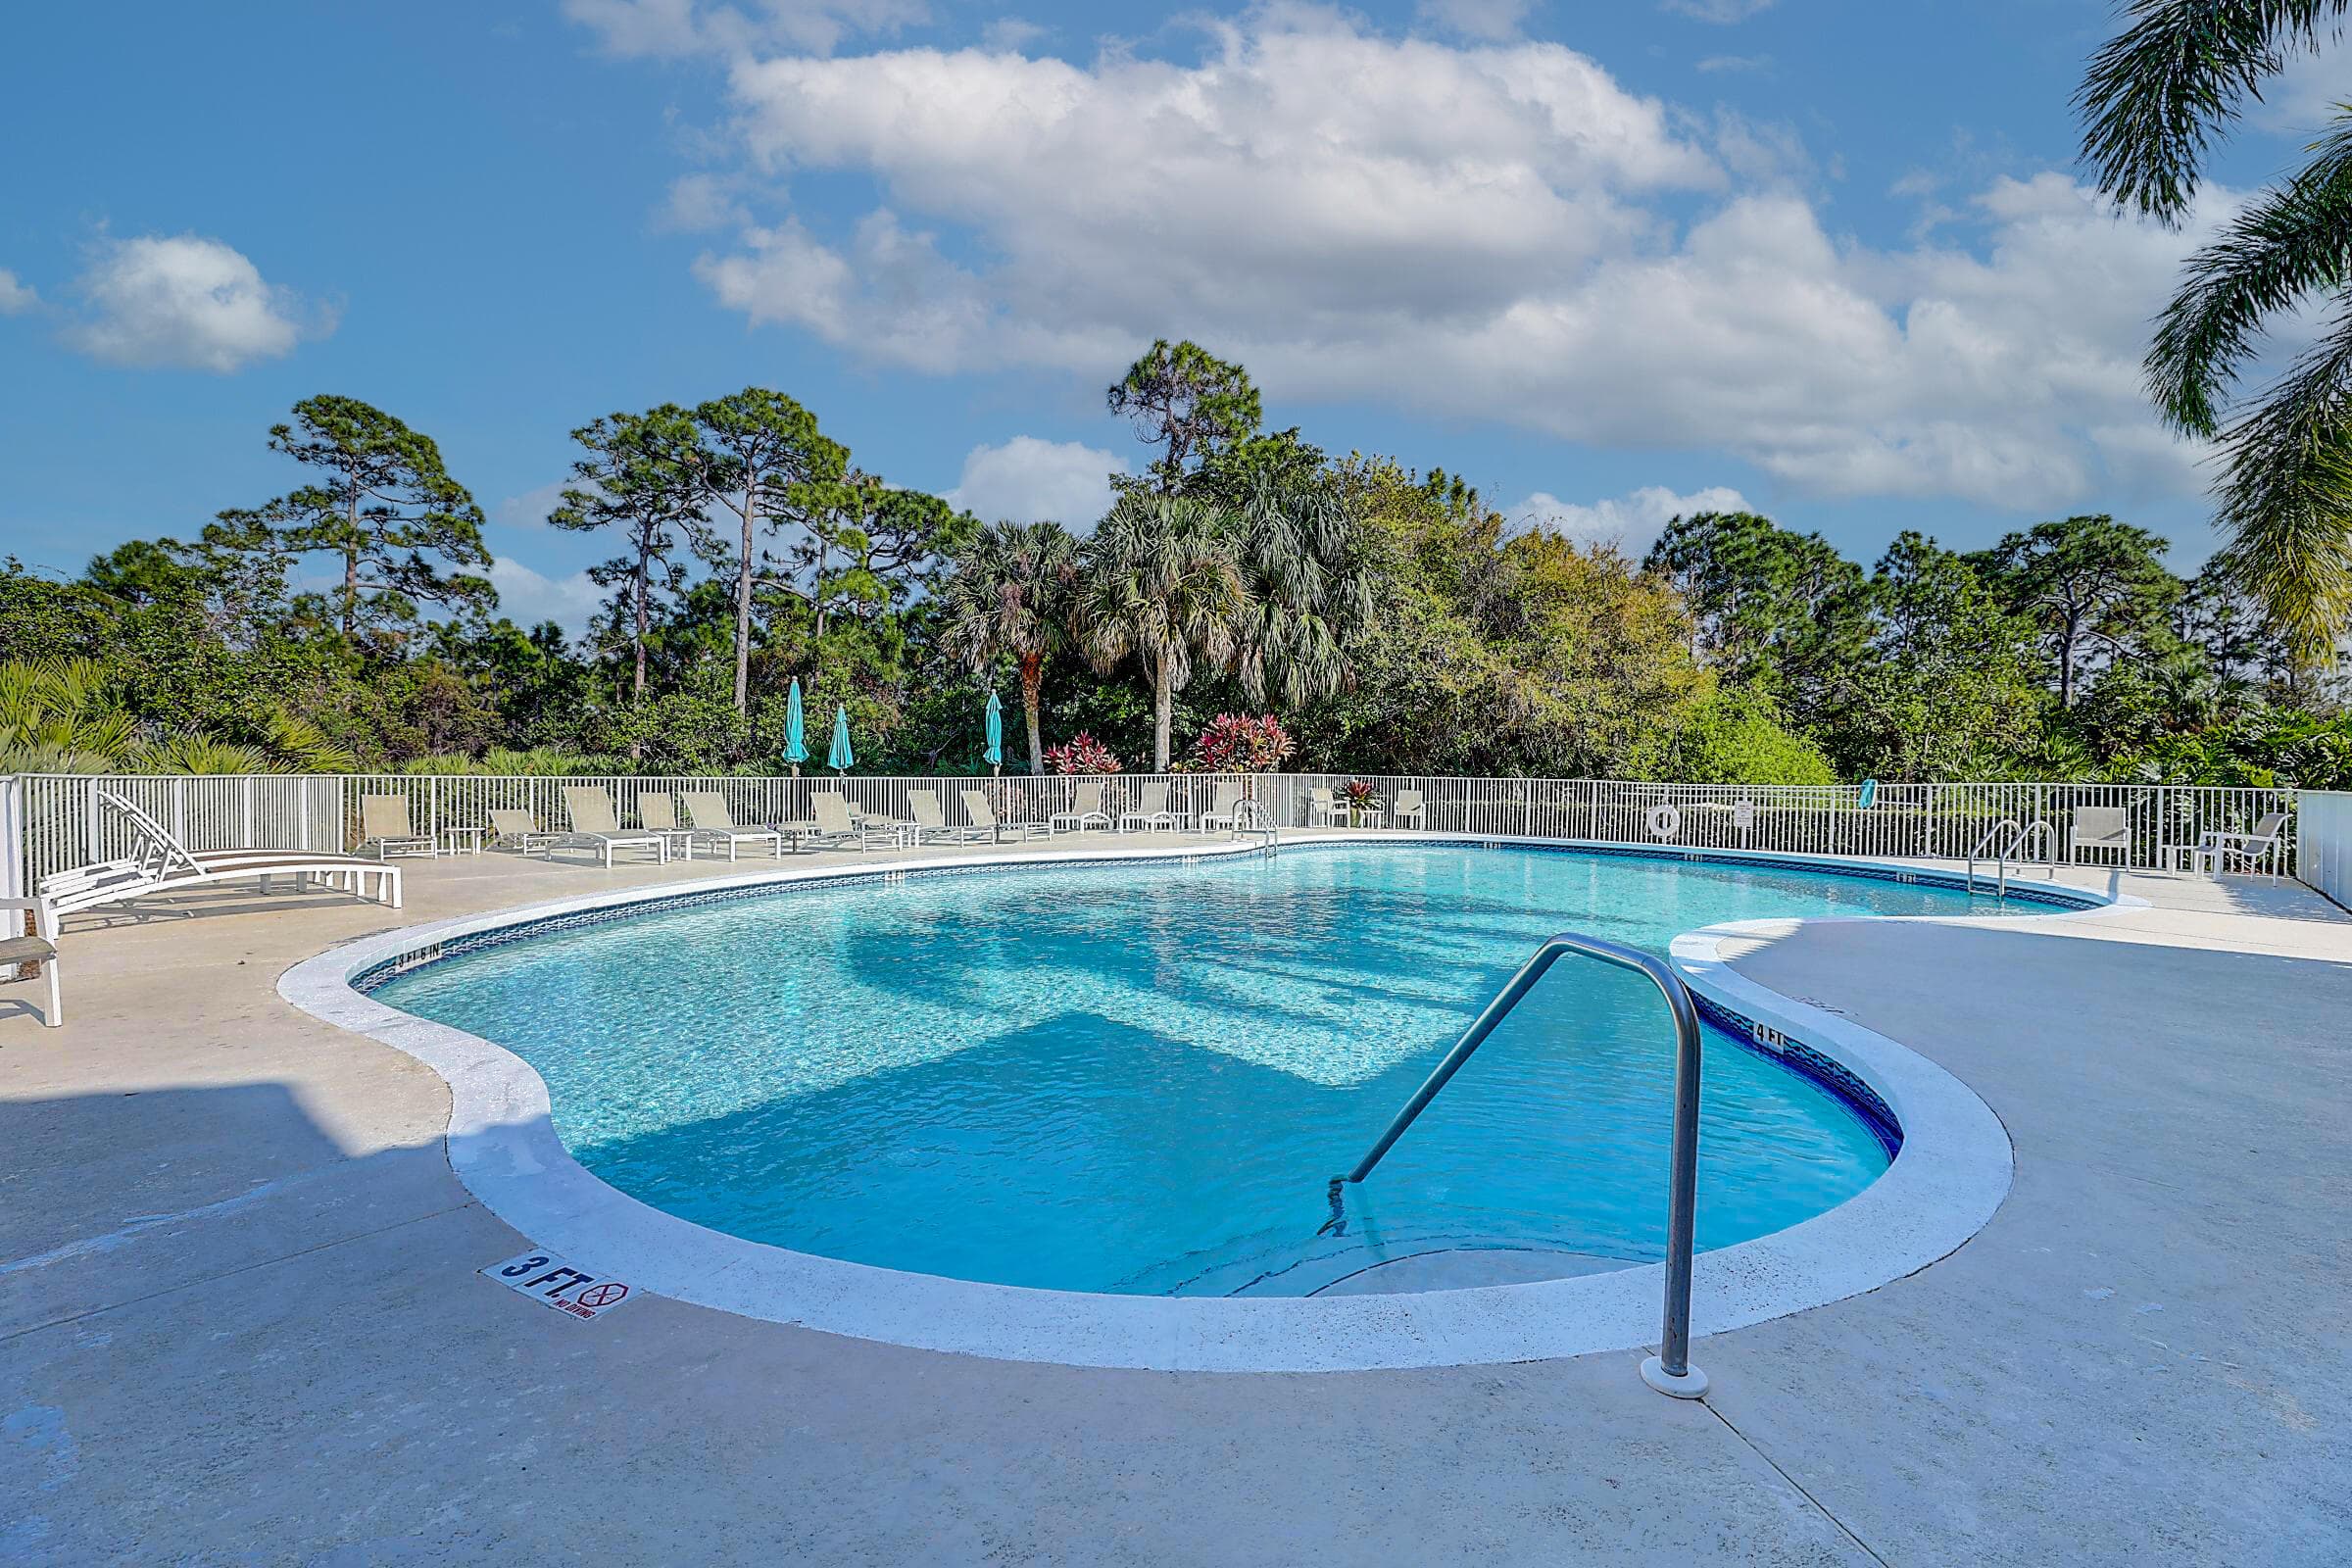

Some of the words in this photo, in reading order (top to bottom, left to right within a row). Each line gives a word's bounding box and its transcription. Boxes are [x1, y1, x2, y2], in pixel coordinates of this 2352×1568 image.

[1906, 874, 1915, 884] FT
[399, 953, 405, 967] 3
[407, 951, 416, 962] FT
[420, 947, 427, 960] 6
[1756, 1023, 1765, 1042] 4
[1768, 1028, 1784, 1046] FT
[501, 1256, 550, 1277] 3
[523, 1266, 596, 1298] FT.
[554, 1298, 571, 1308] NO
[564, 1303, 597, 1319] DIVING
